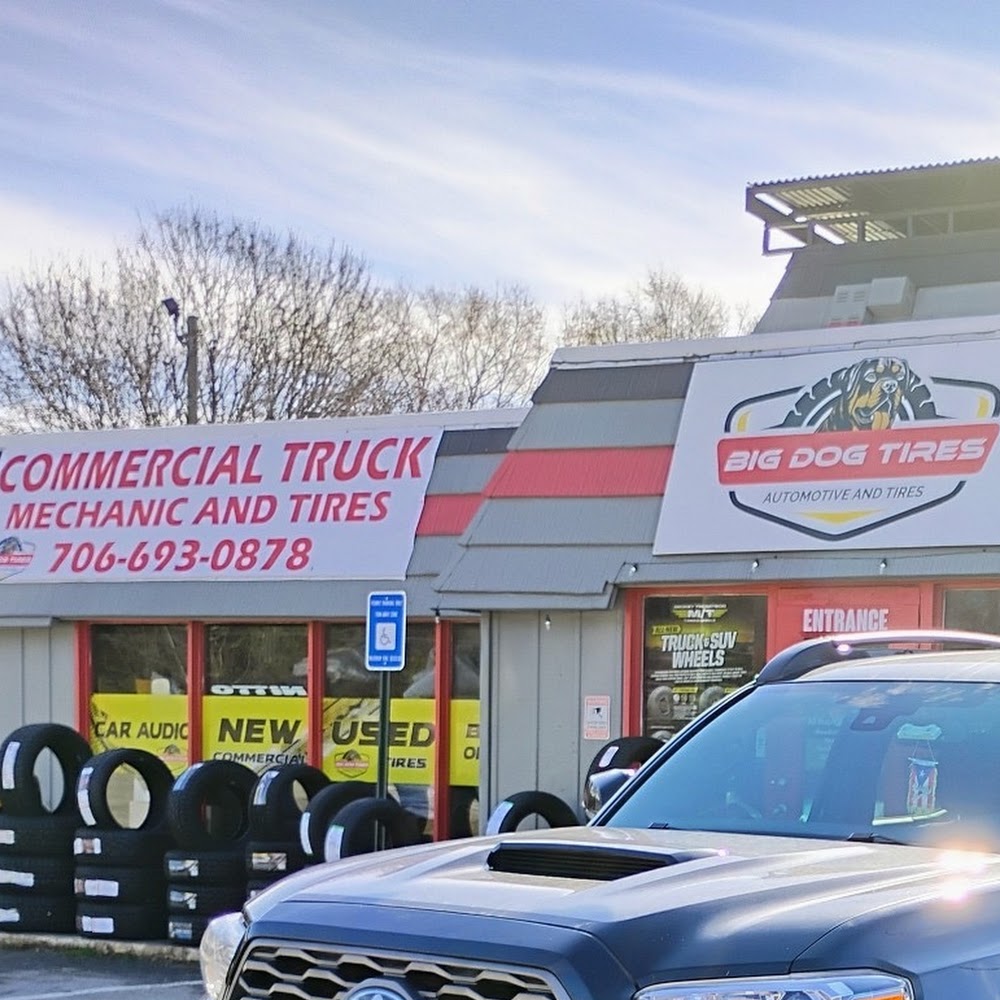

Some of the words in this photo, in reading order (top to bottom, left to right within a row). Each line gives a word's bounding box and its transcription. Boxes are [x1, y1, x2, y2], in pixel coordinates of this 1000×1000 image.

[1, 444, 263, 494] COMMERCIAL
[280, 437, 433, 484] TRUCK
[723, 449, 785, 472] BIG
[788, 444, 869, 469] DOG
[878, 438, 988, 464] TIRES
[762, 489, 851, 504] AUTOMOTIVE
[854, 487, 882, 500] AND
[886, 485, 925, 498] TIRES
[5, 497, 193, 530] MECHANIC
[194, 495, 277, 526] AND
[289, 491, 392, 523] TIRES
[48, 538, 313, 573] 706-693-0878
[803, 608, 889, 632] ENTRANCE
[661, 634, 705, 652] TRUCK
[709, 632, 737, 650] SUV
[672, 650, 725, 668] WHEELS
[94, 721, 131, 738] CAR
[218, 718, 302, 744] NEW
[332, 720, 435, 747] USED
[388, 757, 427, 768] IRES
